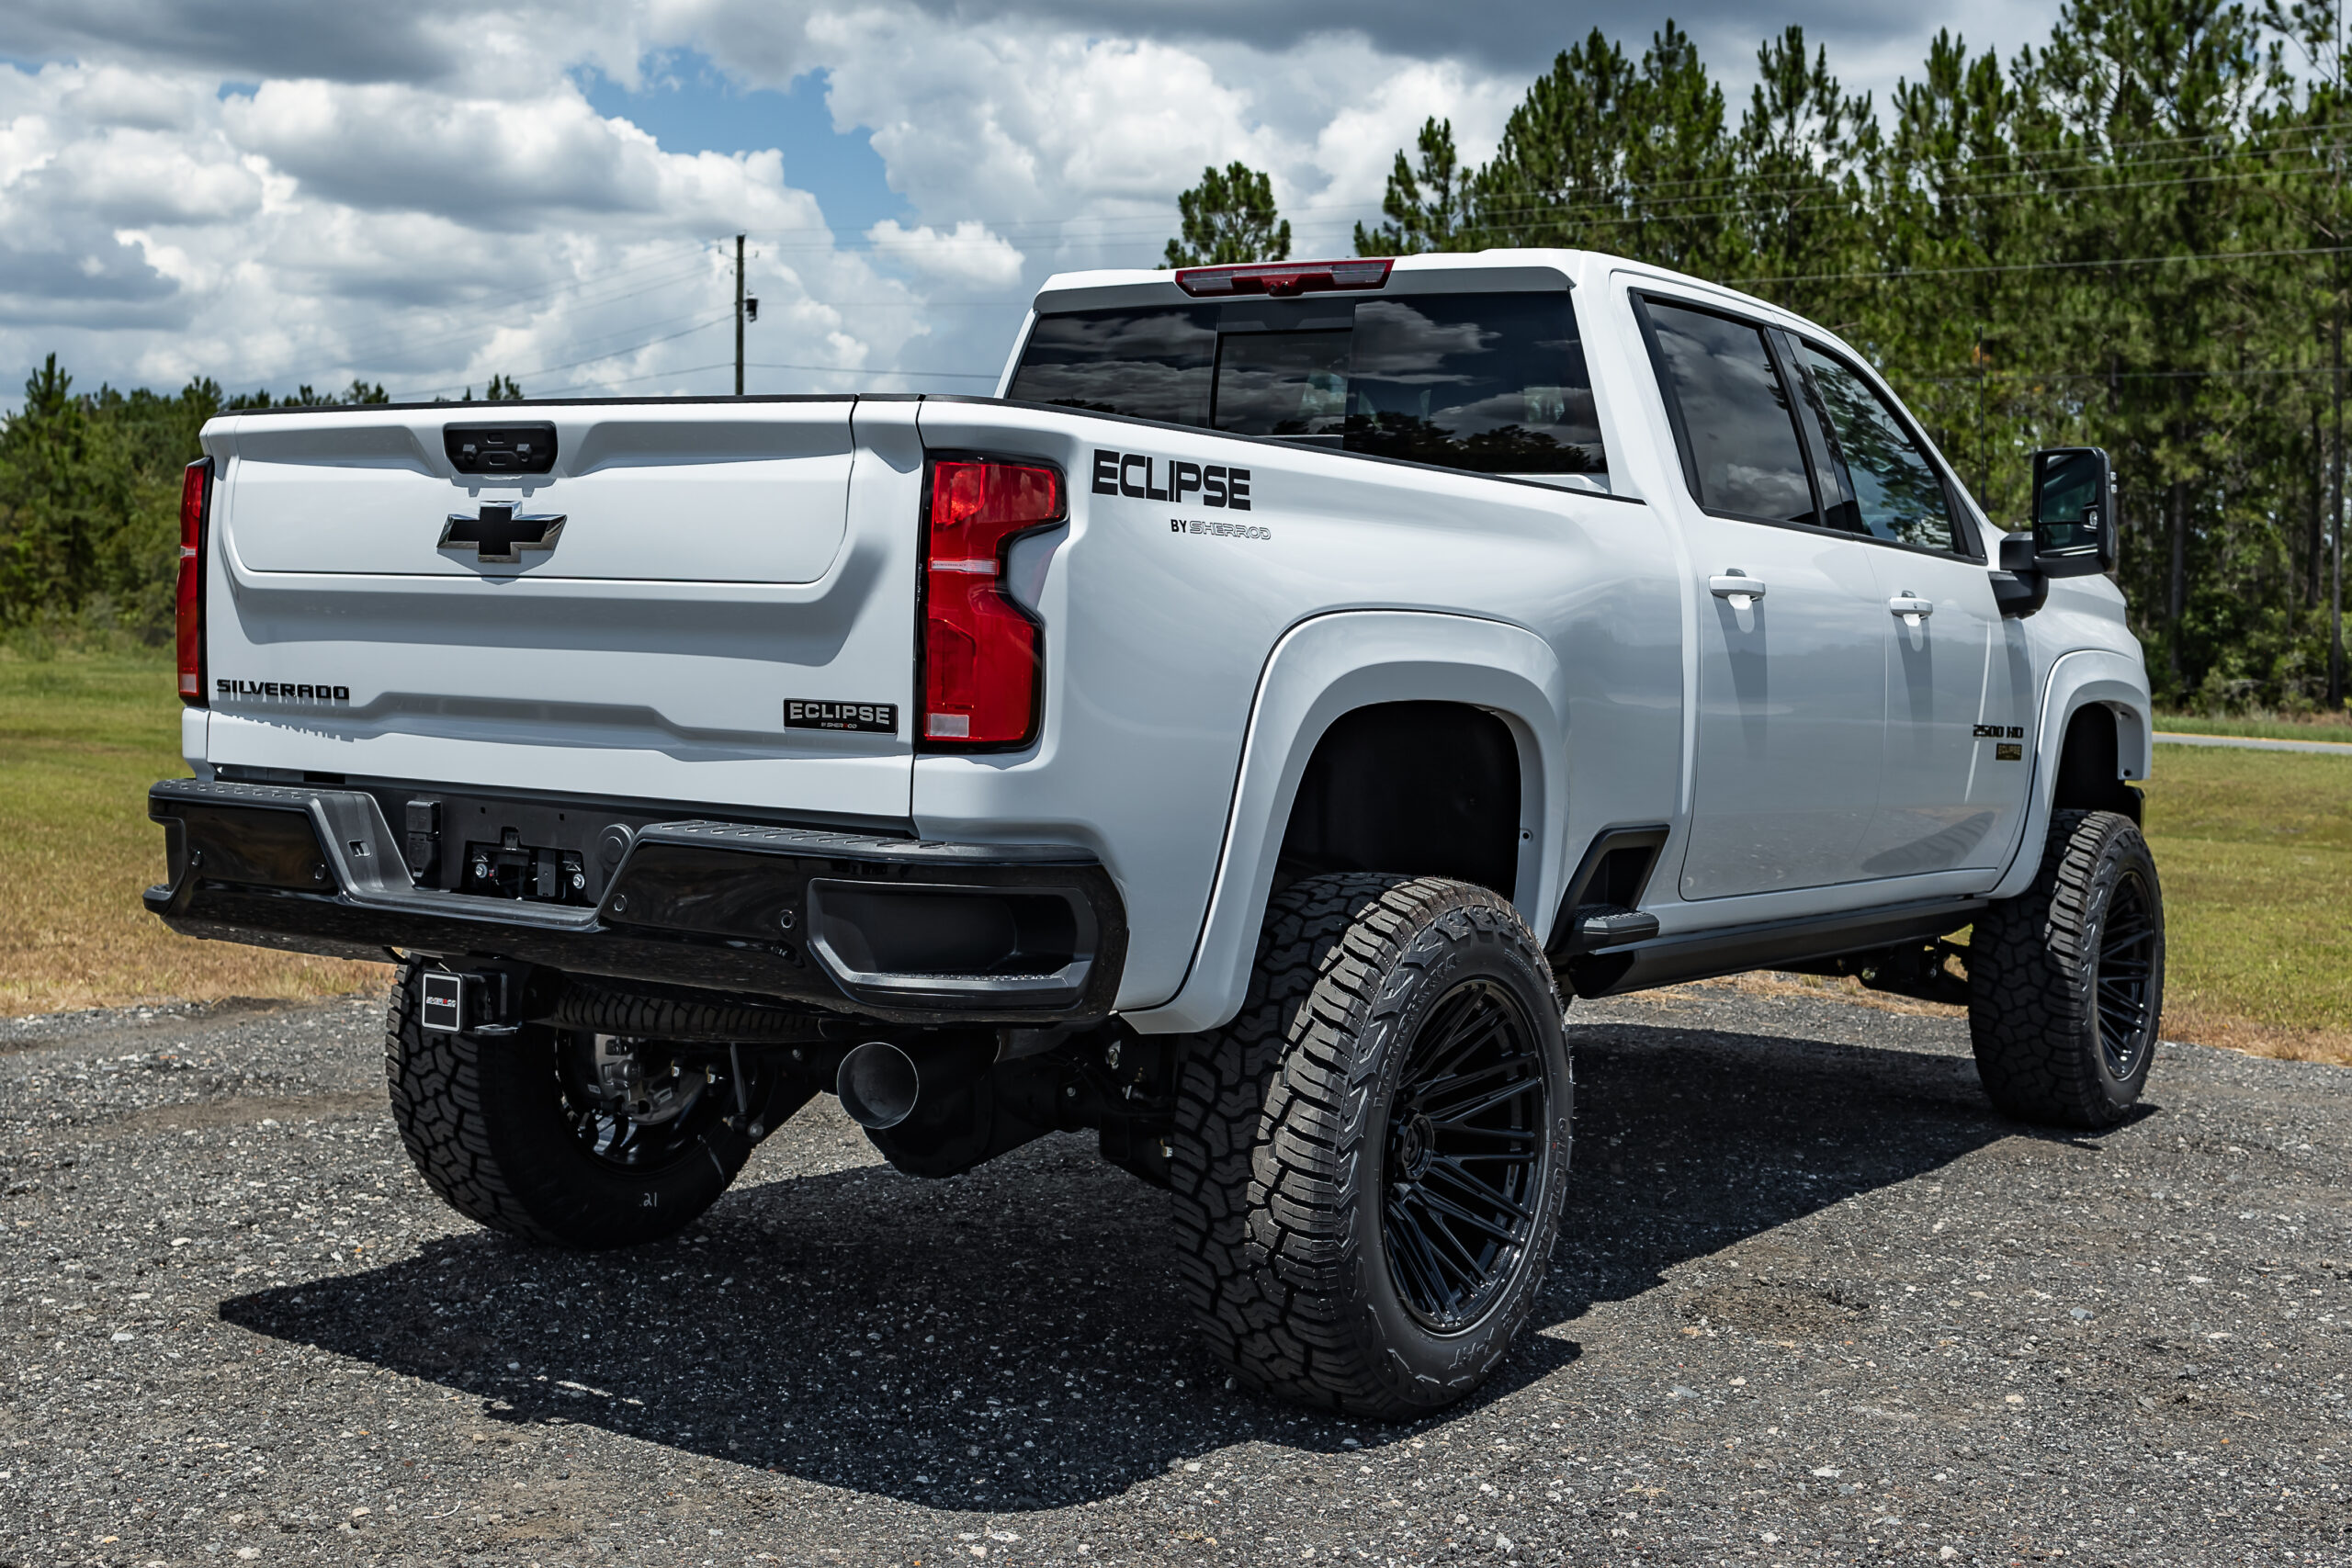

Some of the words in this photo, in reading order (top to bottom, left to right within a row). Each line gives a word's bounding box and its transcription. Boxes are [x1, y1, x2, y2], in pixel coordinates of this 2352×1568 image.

[1091, 448, 1251, 511] ECLIPSE
[1170, 519, 1187, 533] BY
[1189, 520, 1272, 540] SHERROD
[217, 678, 350, 700] SILVERADO
[789, 702, 889, 725] ECLIPSE
[1973, 724, 2005, 738] 2500
[2006, 726, 2024, 739] HD
